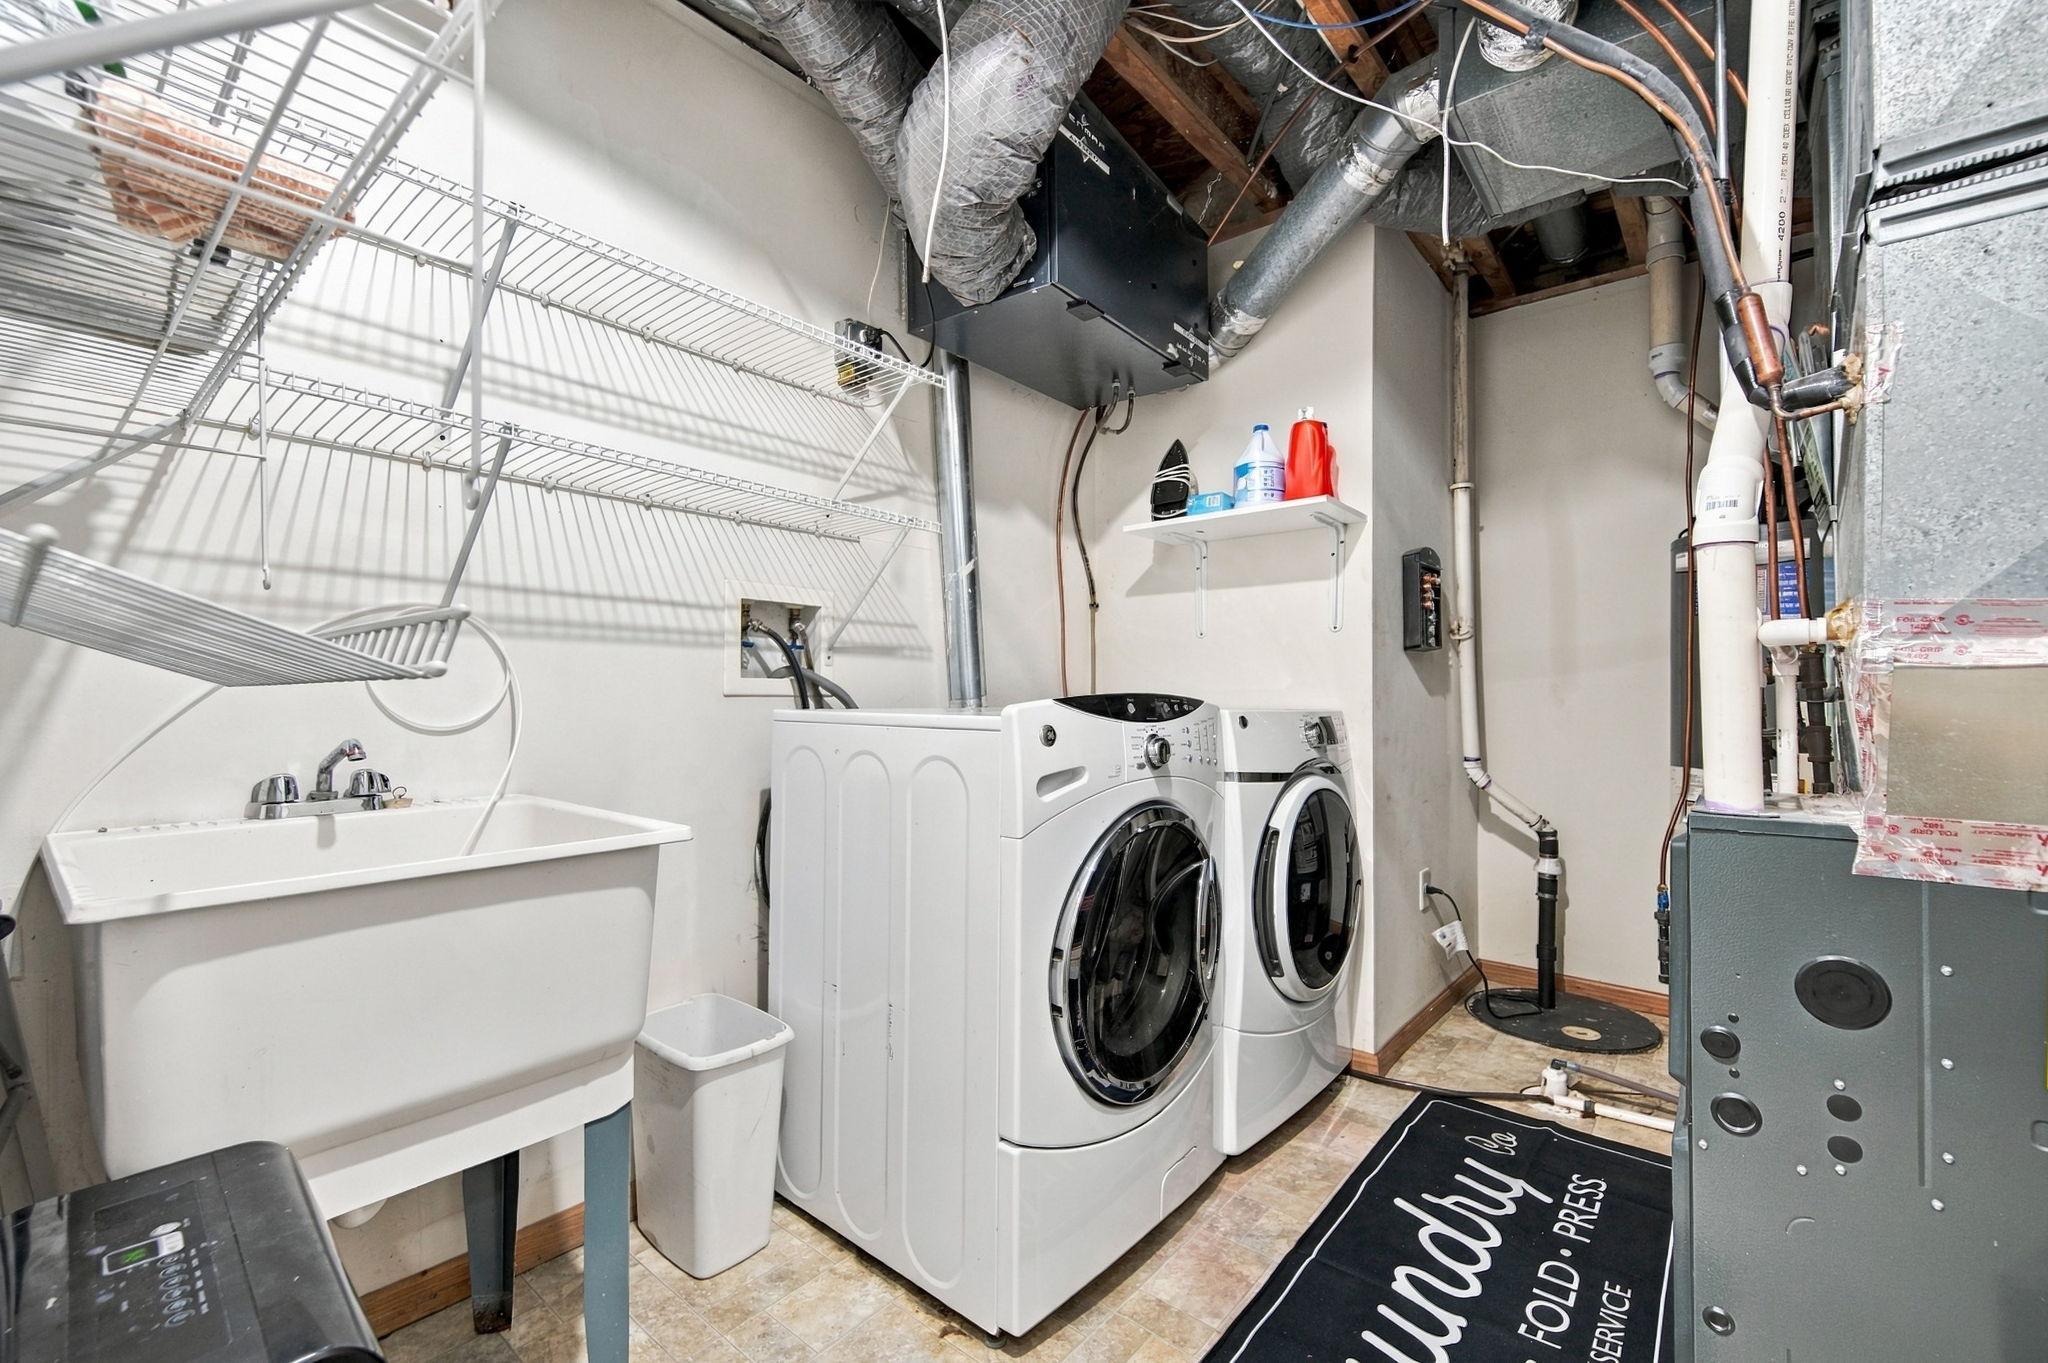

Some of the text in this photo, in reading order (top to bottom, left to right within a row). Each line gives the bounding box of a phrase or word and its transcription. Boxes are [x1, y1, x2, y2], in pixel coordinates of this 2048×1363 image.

[1784, 88, 1792, 120] CELLULAR
[1781, 153, 1789, 166] SCH
[1778, 211, 1786, 242] 4200
[1346, 1131, 1554, 1363] undry Co
[1517, 1173, 1608, 1350] FOLD PRESS
[1588, 1280, 1632, 1363] SERVICE
